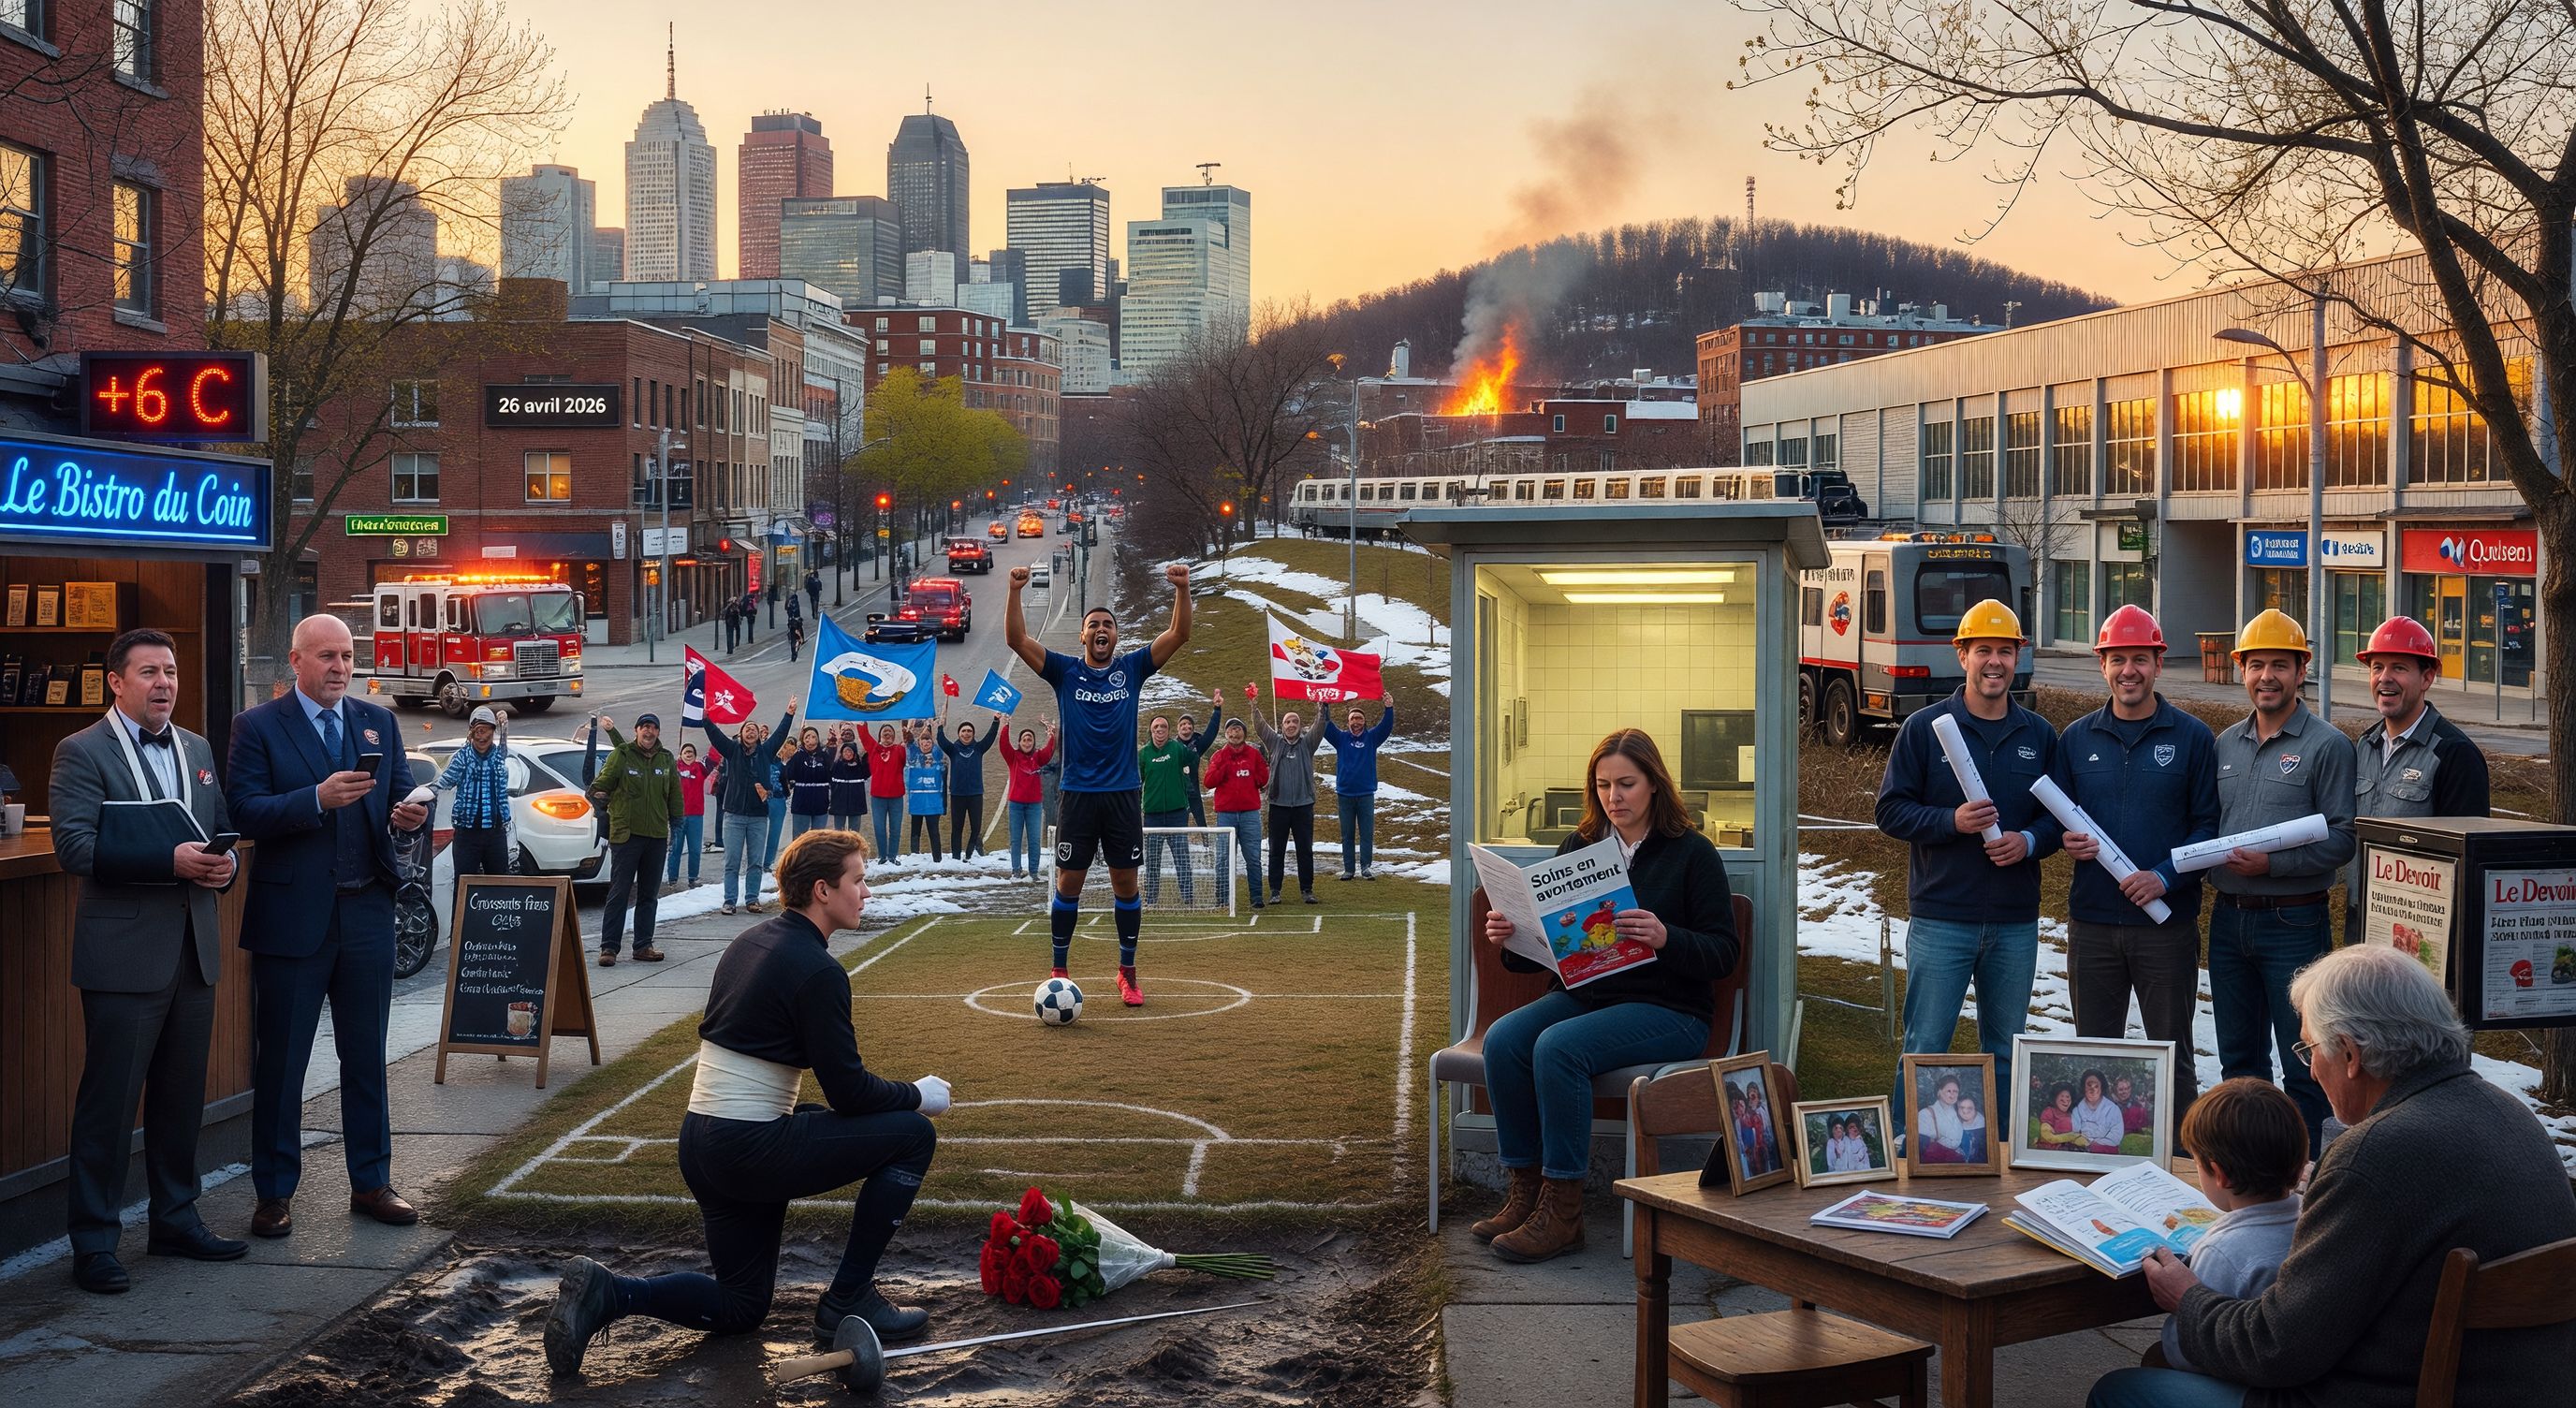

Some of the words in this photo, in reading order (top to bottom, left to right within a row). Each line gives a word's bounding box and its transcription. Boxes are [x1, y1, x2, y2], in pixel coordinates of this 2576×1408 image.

[98, 366, 167, 423] +6
[192, 367, 229, 423] C
[498, 397, 520, 414] 26
[524, 397, 560, 414] avril
[564, 397, 607, 414] 2026
[0, 456, 46, 515] Le
[51, 461, 145, 521] Bistro
[154, 471, 190, 524] du
[197, 473, 253, 528] Coin
[1530, 867, 1574, 888] Soins
[1576, 858, 1596, 872] en
[2375, 855, 2393, 881] Le
[2394, 859, 2442, 891] Devoir
[2494, 878, 2519, 903] Le
